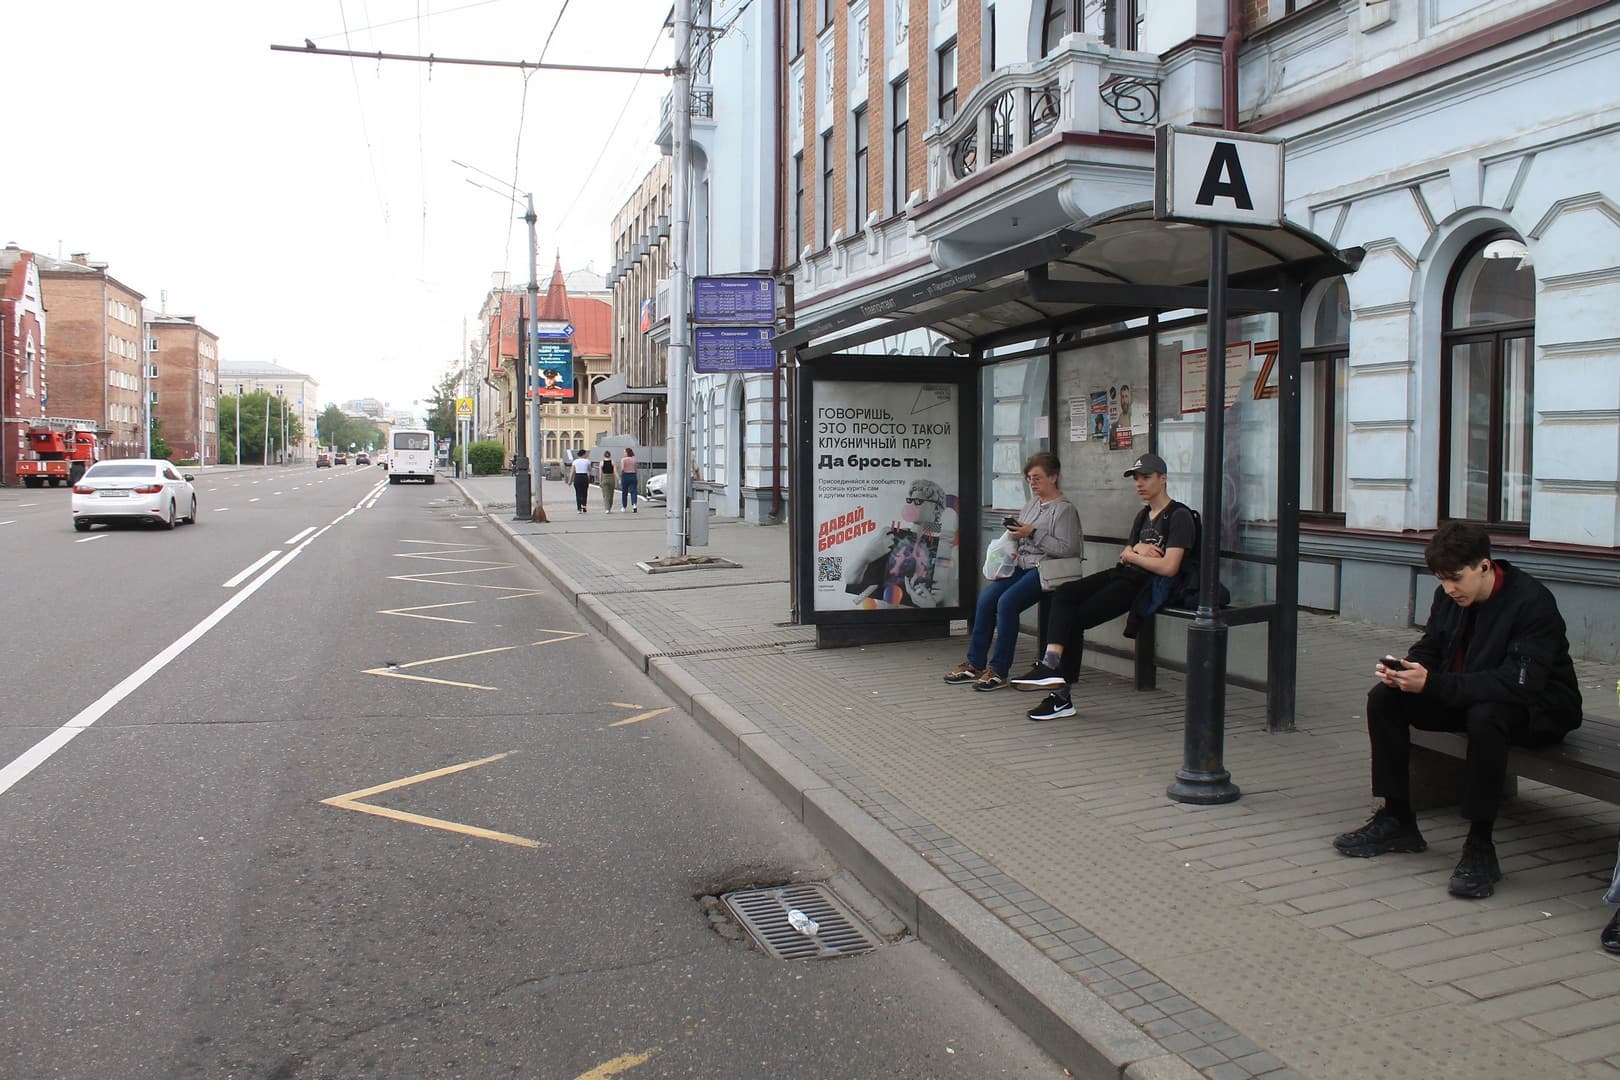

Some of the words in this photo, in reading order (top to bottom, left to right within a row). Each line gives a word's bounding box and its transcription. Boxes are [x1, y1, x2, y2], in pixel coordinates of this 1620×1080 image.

[1195, 142, 1254, 210] А
[818, 408, 894, 421] ГОВОРИШЬ,
[818, 423, 846, 434] ЭТО
[853, 423, 907, 435] ПРОСТО
[912, 422, 951, 435] ТАКОЙ
[903, 438, 932, 449] ПАР?
[818, 455, 844, 470] Да
[847, 455, 901, 470] брось
[904, 458, 931, 468] ты.
[818, 478, 865, 486] Присоединяйся
[819, 505, 865, 538] ДАВАЙ
[818, 520, 876, 552] БРОСАТЬ
